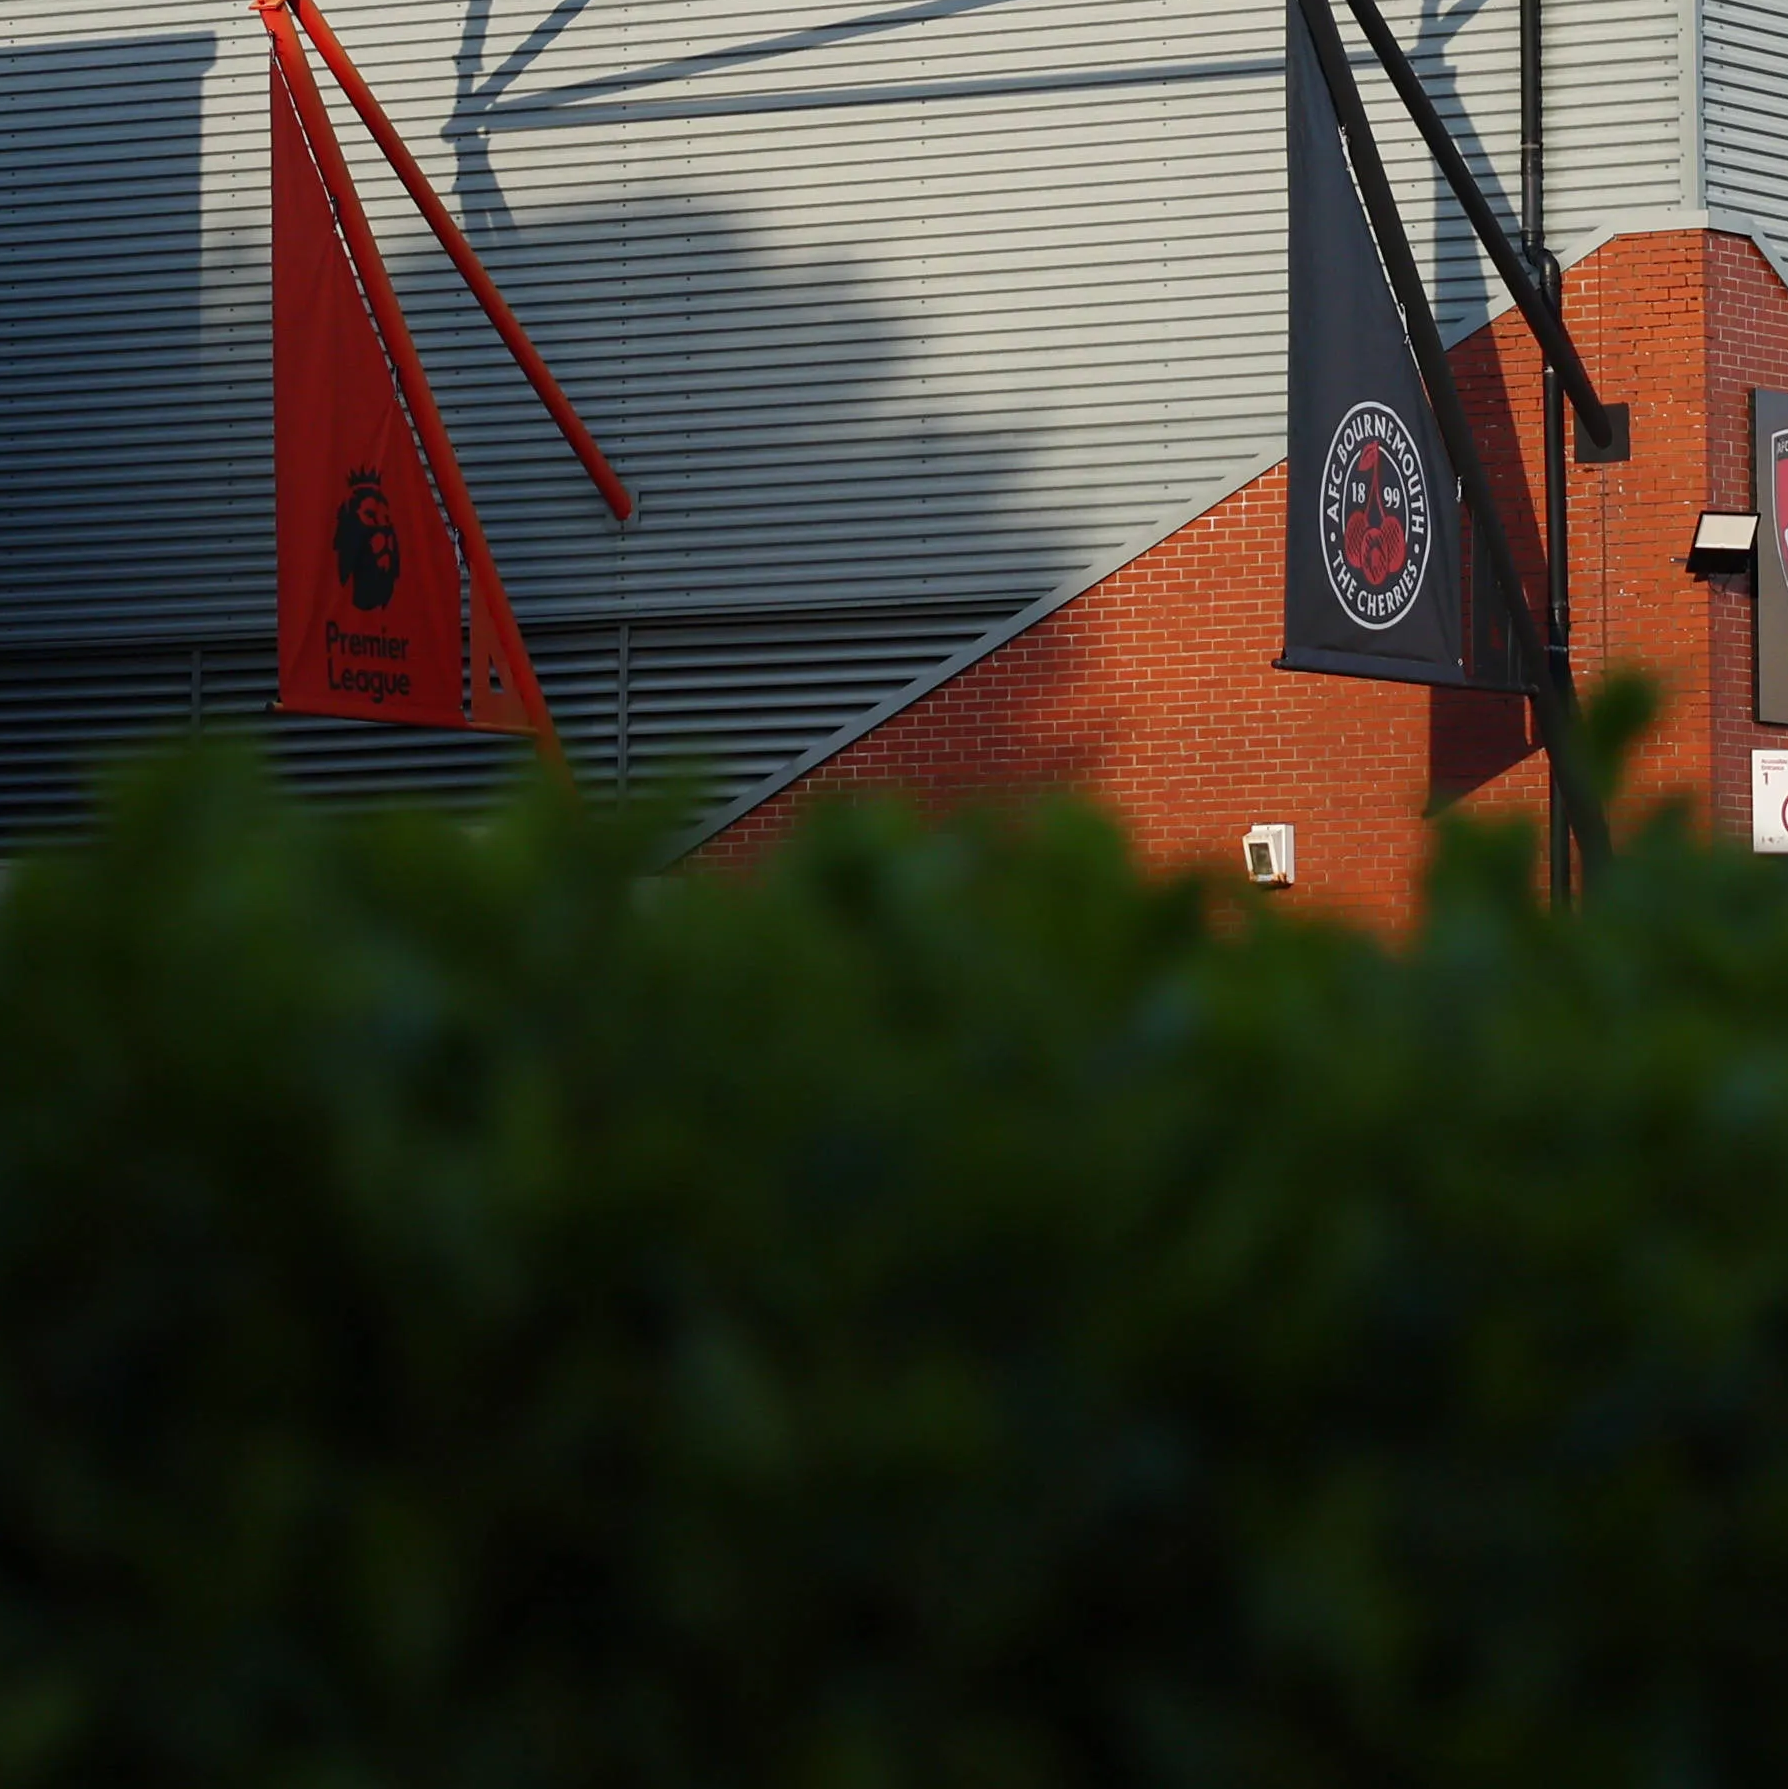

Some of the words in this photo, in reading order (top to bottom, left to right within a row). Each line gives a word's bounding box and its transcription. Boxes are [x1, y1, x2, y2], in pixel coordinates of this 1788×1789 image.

[1326, 464, 1342, 523] AFC
[1337, 413, 1425, 534] BOURNEMOUTH
[1351, 481, 1366, 504] 18
[1383, 484, 1400, 509] 99
[1330, 550, 1358, 601] THE
[1357, 559, 1418, 617] CHERRIES
[325, 620, 410, 661] Premier
[327, 657, 410, 704] League
[1762, 772, 1769, 786] 1
